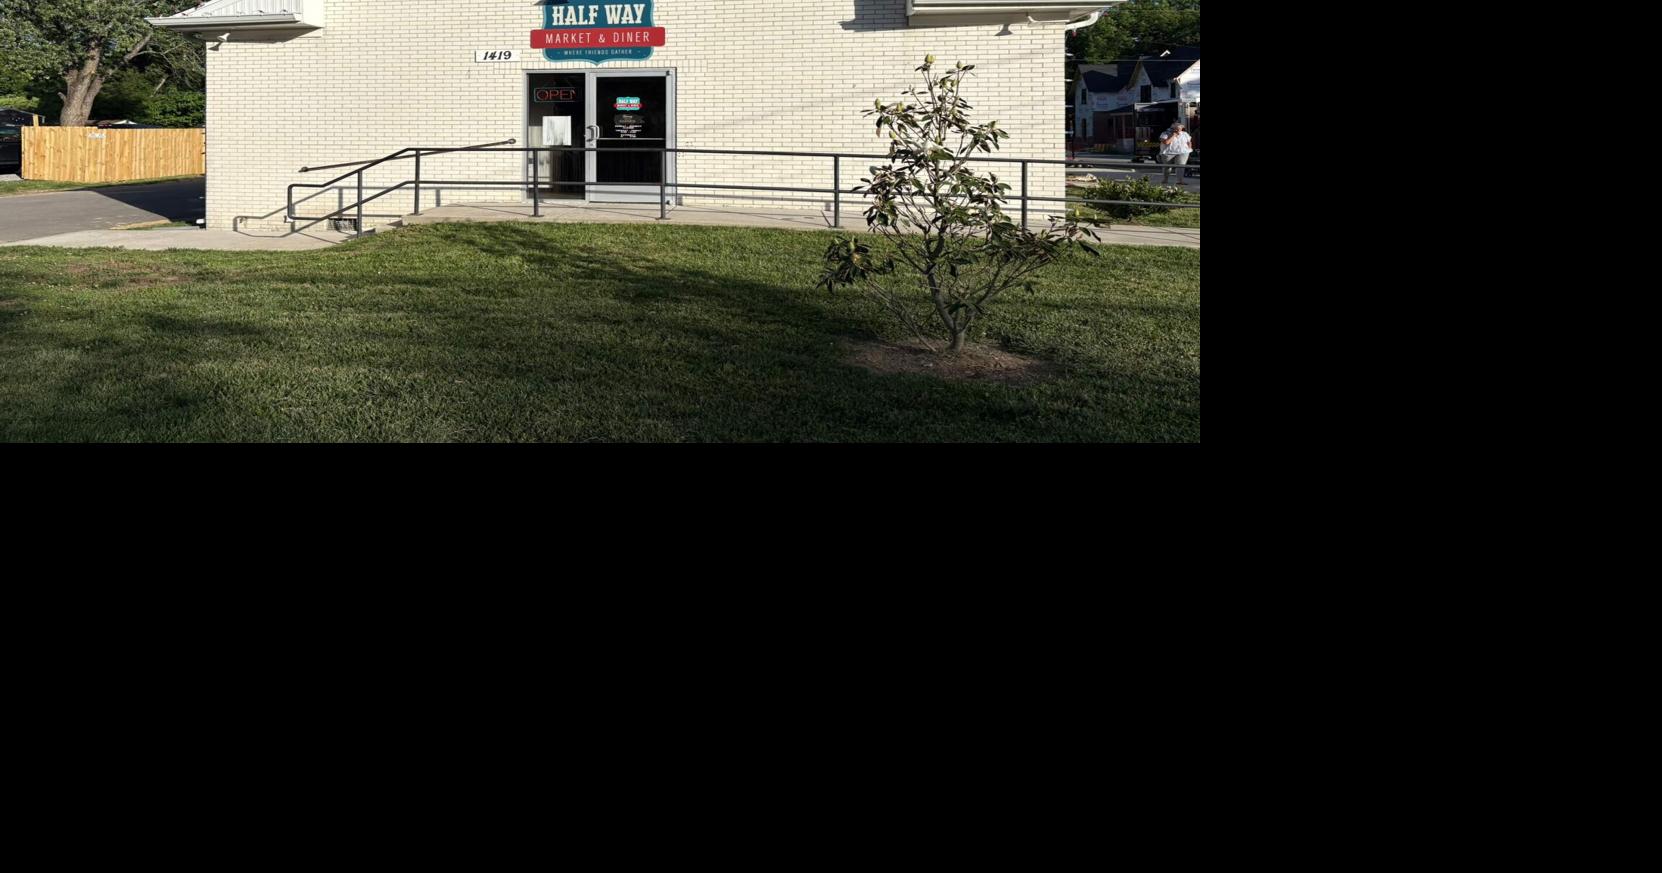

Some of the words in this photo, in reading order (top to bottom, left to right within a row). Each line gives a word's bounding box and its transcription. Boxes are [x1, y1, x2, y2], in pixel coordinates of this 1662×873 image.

[552, 5, 599, 25] HALF
[604, 4, 645, 24] WAY
[545, 32, 591, 44] MARKET
[598, 33, 606, 43] &
[613, 31, 650, 43] DINER
[483, 50, 512, 60] 1419
